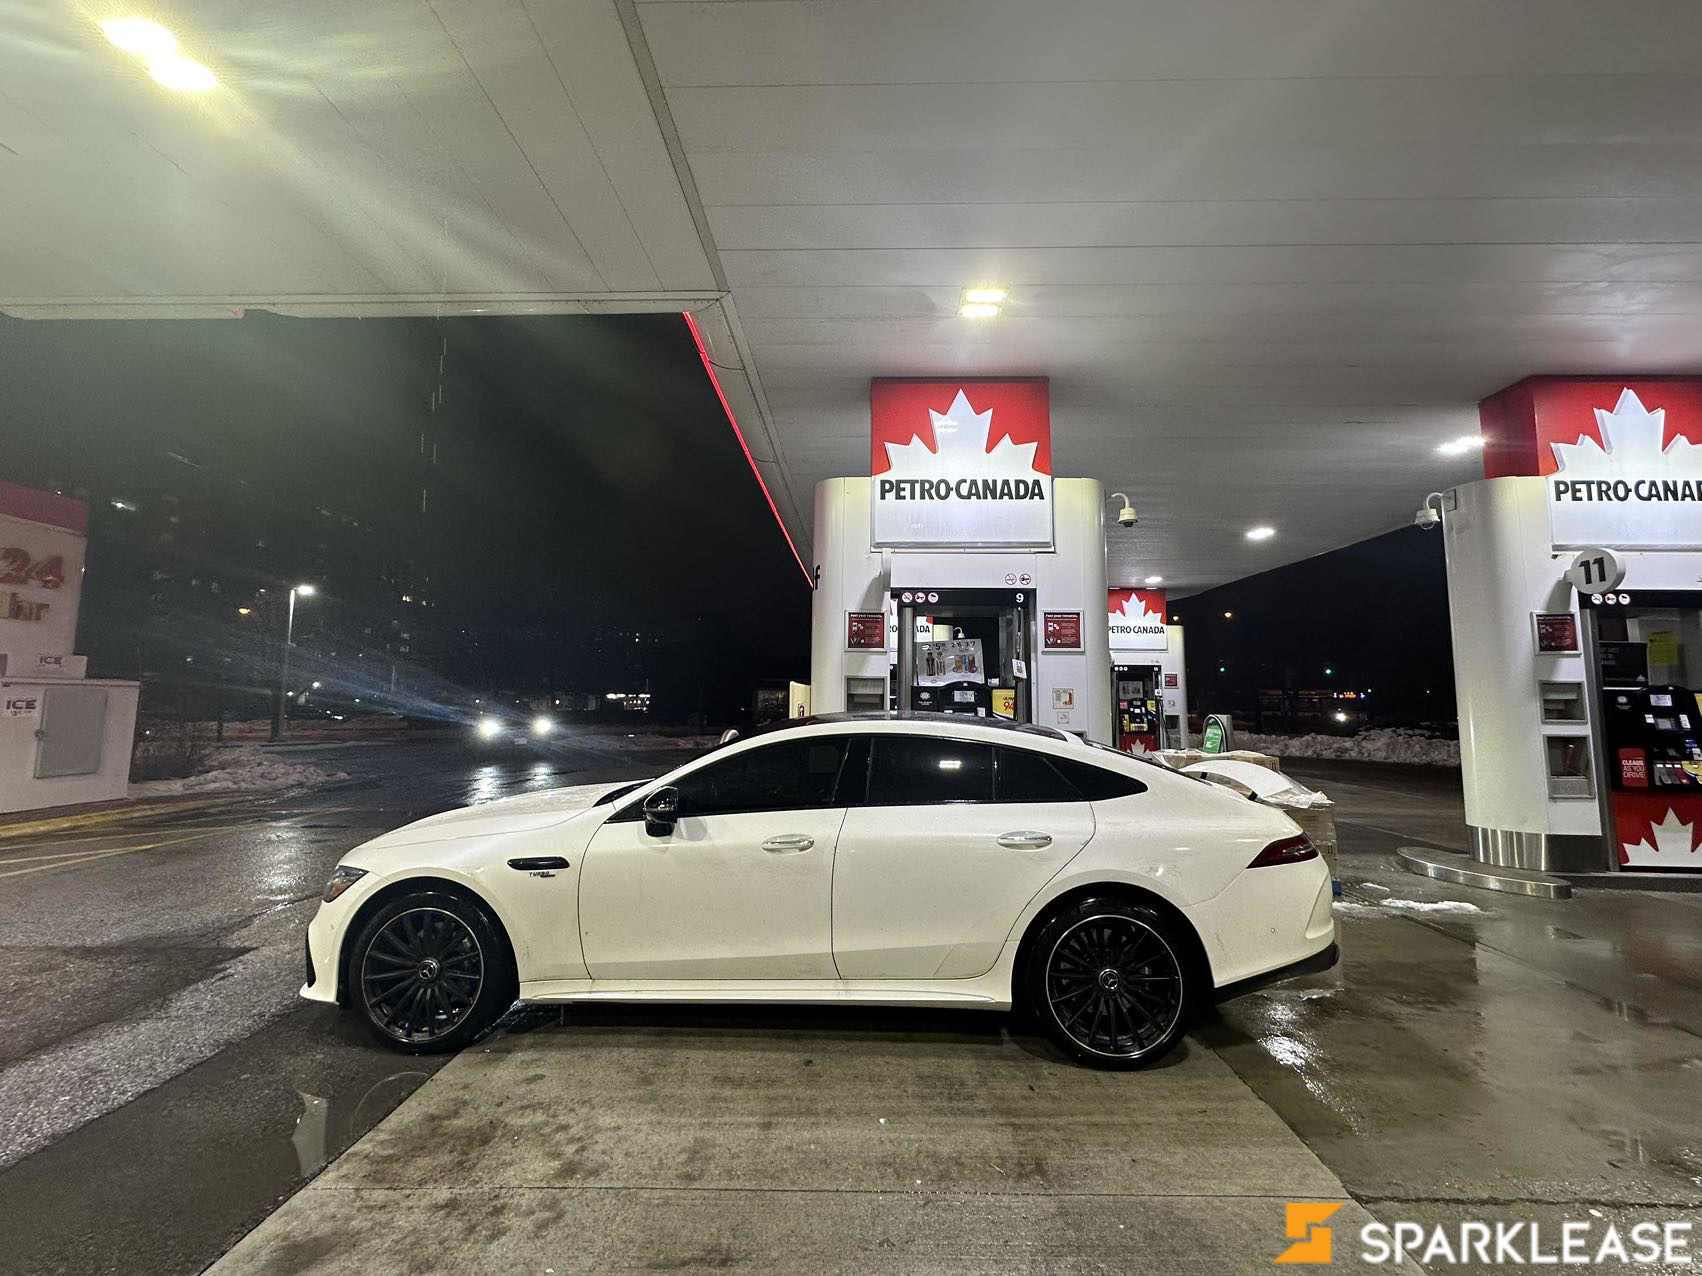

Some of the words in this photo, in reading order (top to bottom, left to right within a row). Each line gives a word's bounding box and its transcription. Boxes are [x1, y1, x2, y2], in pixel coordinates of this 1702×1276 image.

[1578, 556, 1607, 585] 11
[1015, 593, 1024, 603] 9
[39, 655, 62, 665] ICE
[6, 699, 37, 710] ICE
